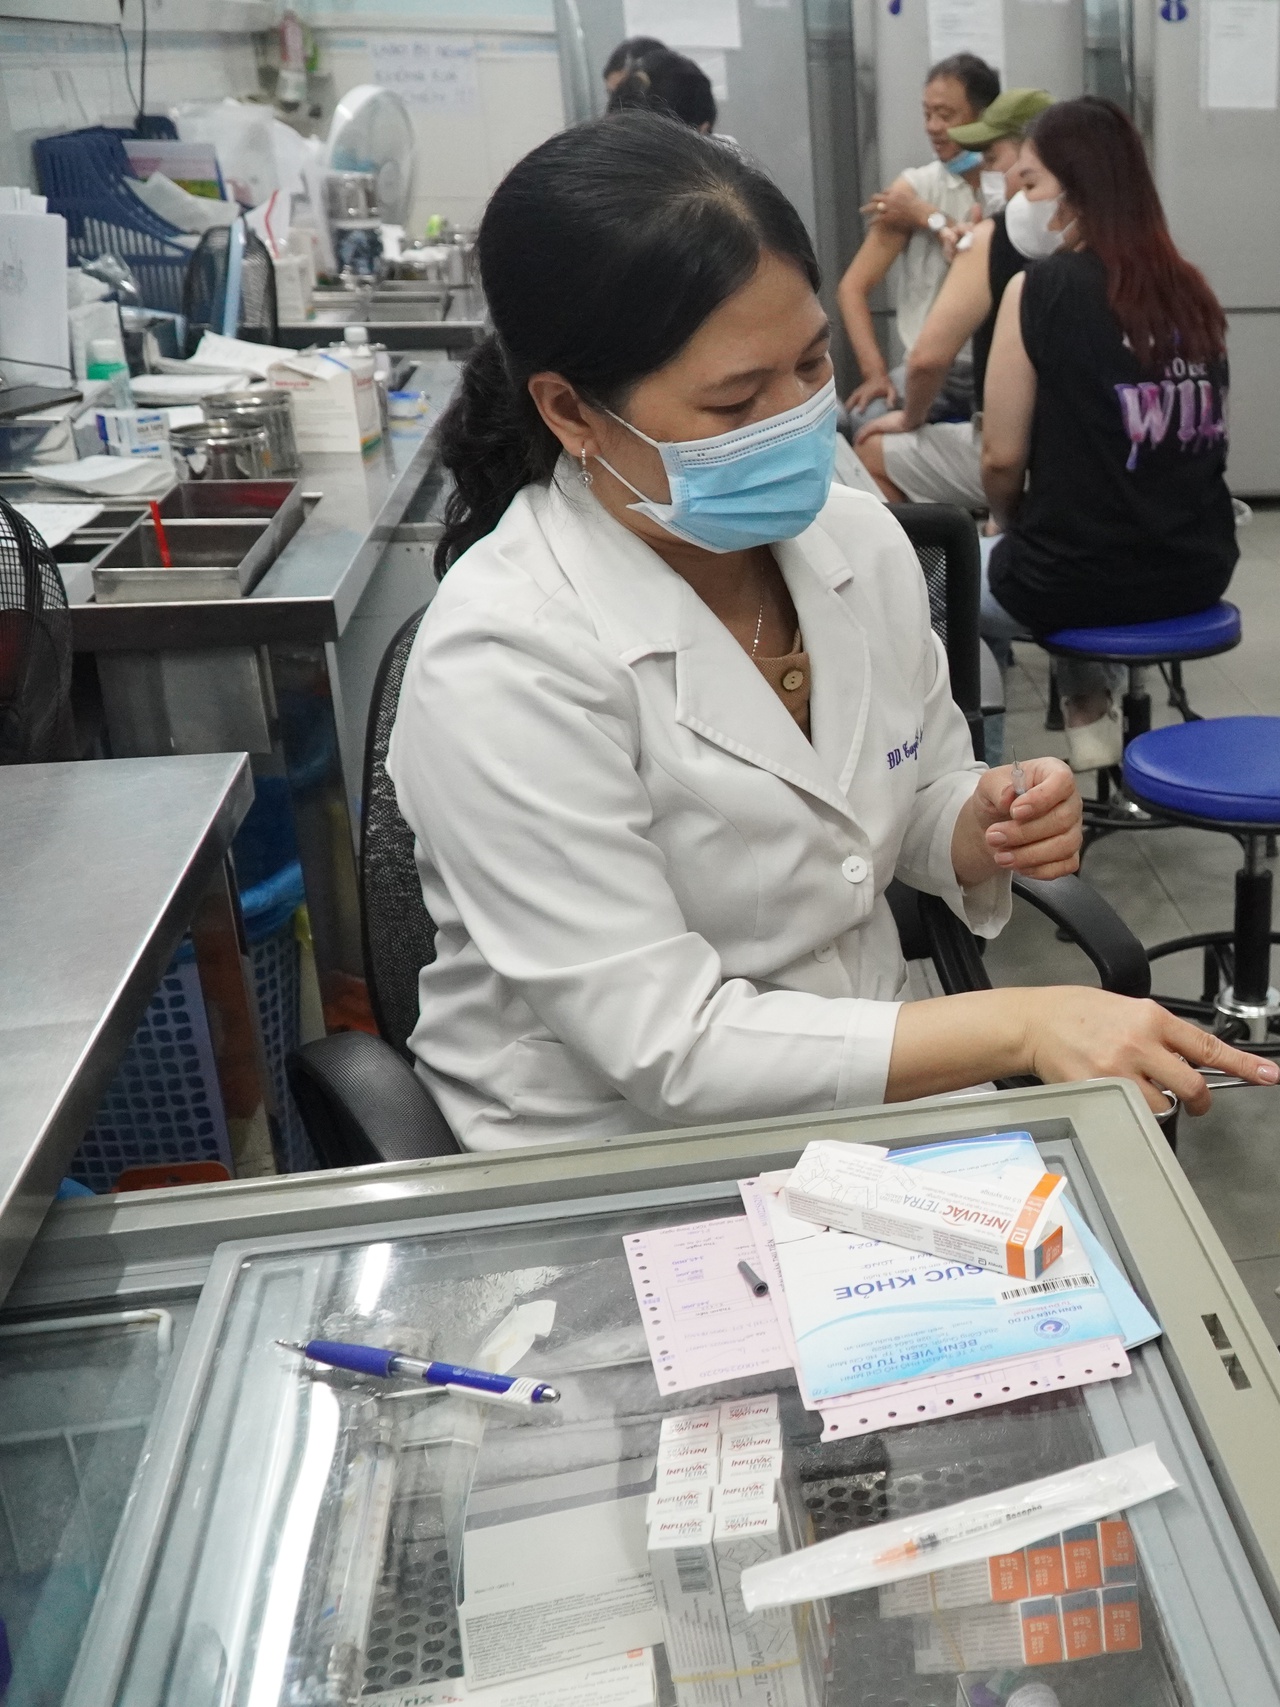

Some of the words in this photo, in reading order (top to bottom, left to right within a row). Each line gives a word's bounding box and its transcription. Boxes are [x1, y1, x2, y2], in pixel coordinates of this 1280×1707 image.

[904, 1195, 939, 1213] TETRA
[943, 1205, 1011, 1234] INFLUVAC
[924, 1264, 983, 1283] SỨC
[833, 1274, 916, 1301] KHỎE
[750, 1651, 769, 1686] TERA
